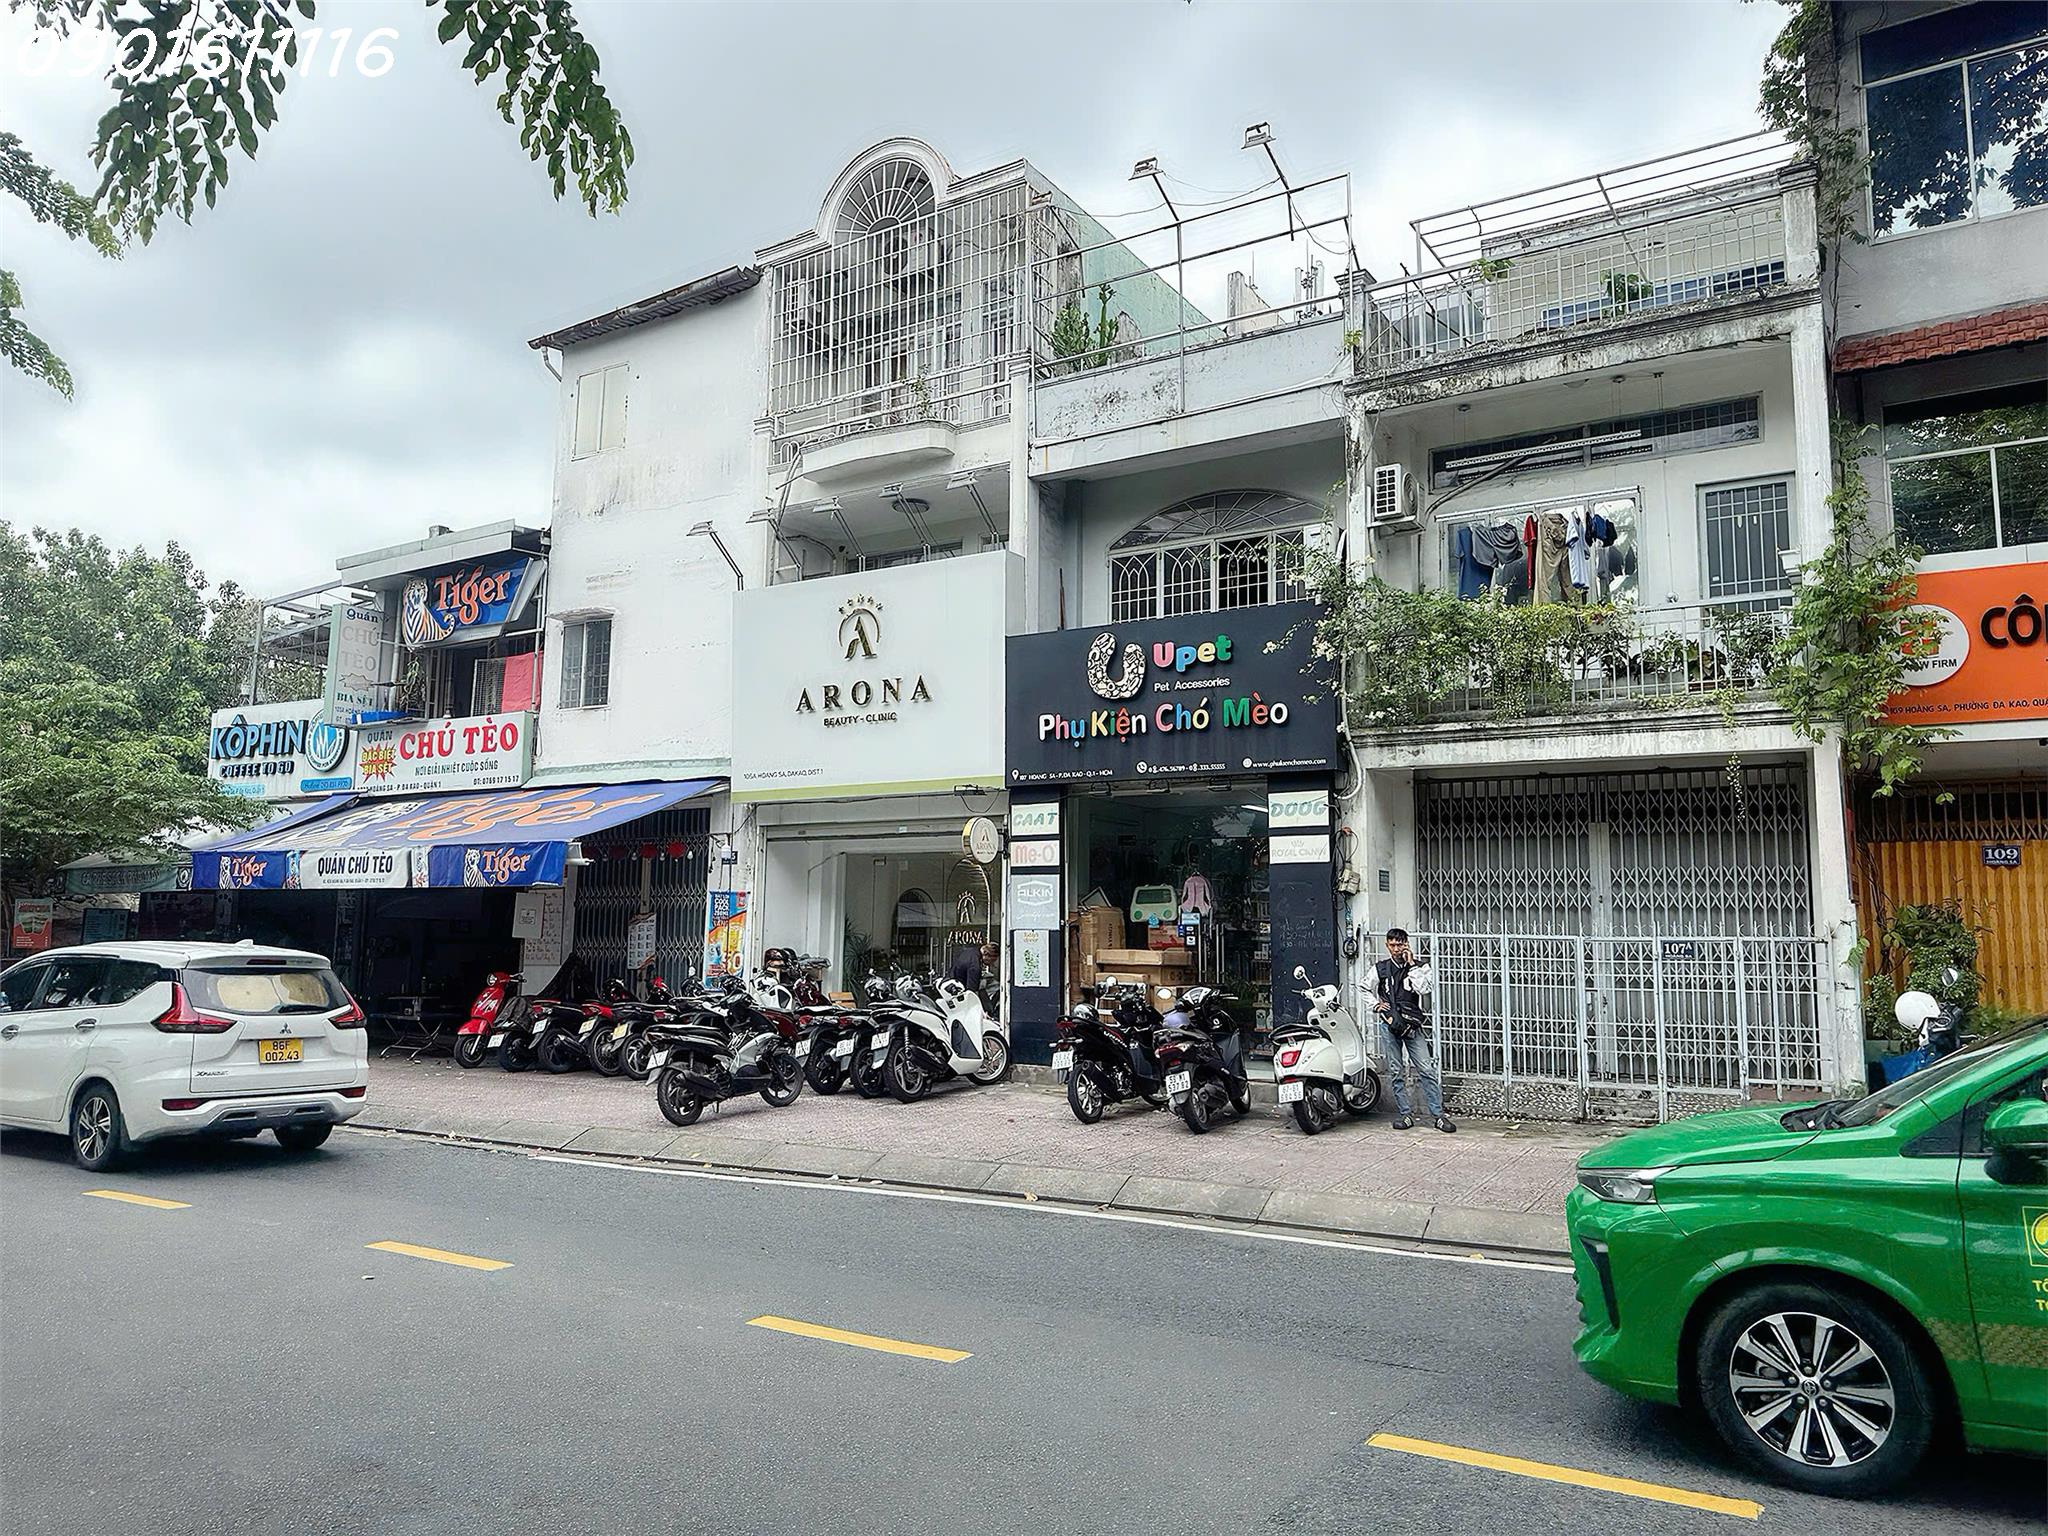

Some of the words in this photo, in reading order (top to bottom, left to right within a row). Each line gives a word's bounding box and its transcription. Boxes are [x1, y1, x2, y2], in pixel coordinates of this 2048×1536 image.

[433, 564, 511, 625] Tiger
[1980, 592, 2048, 649] CÔ
[342, 626, 379, 647] CHÚ
[1152, 633, 1233, 673] Upet
[1931, 658, 1958, 670] FIRM
[794, 675, 932, 714] ARONA
[1154, 682, 1170, 692] Pet
[1174, 677, 1230, 691] Accessories
[823, 715, 859, 727] BEAUTY
[1038, 712, 1085, 748] Phụ
[1090, 707, 1148, 743] Kiện
[1155, 697, 1210, 732] Chó
[1223, 691, 1290, 729] Mèo
[400, 722, 456, 760] CHÚ
[463, 717, 519, 755] TÈO
[219, 763, 260, 778] COFFEE
[261, 762, 277, 775] TO
[277, 760, 295, 774] GO
[1012, 811, 1058, 827] CAAT
[317, 852, 346, 877] QUÁN
[347, 851, 369, 874] CHÚ
[373, 850, 393, 874] TÈO
[481, 846, 530, 884] Tiger
[1985, 848, 2018, 860] 109
[231, 854, 268, 886] Tiger
[264, 1051, 299, 1062] 002.43
[272, 1040, 290, 1051] 86F
